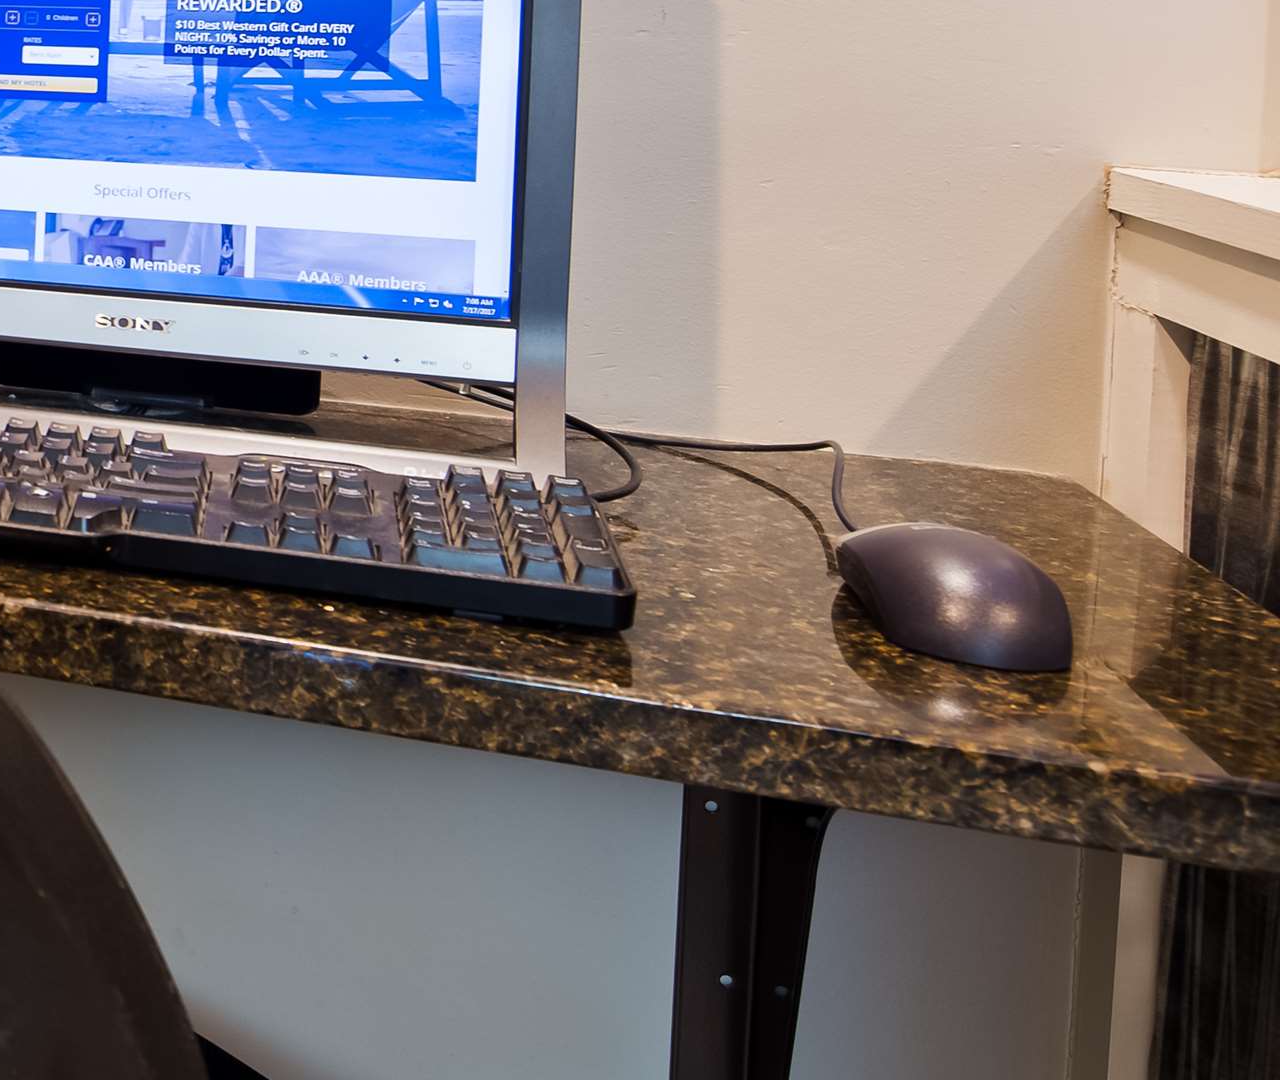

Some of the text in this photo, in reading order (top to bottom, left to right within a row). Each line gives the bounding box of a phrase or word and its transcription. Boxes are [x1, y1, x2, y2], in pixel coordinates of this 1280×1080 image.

[175, 20, 354, 34] $10 Best Western Gift Card EVERY
[174, 32, 212, 43] NIGHT.
[216, 34, 237, 44] 10%
[239, 34, 281, 47] Savings
[297, 36, 329, 46] More.
[332, 36, 346, 47] 10
[174, 44, 328, 60] Points for Every Dollar Spent.
[93, 183, 191, 202] Special Offers
[129, 256, 202, 276] Members
[348, 273, 427, 292] Members
[95, 313, 175, 334] SONY
